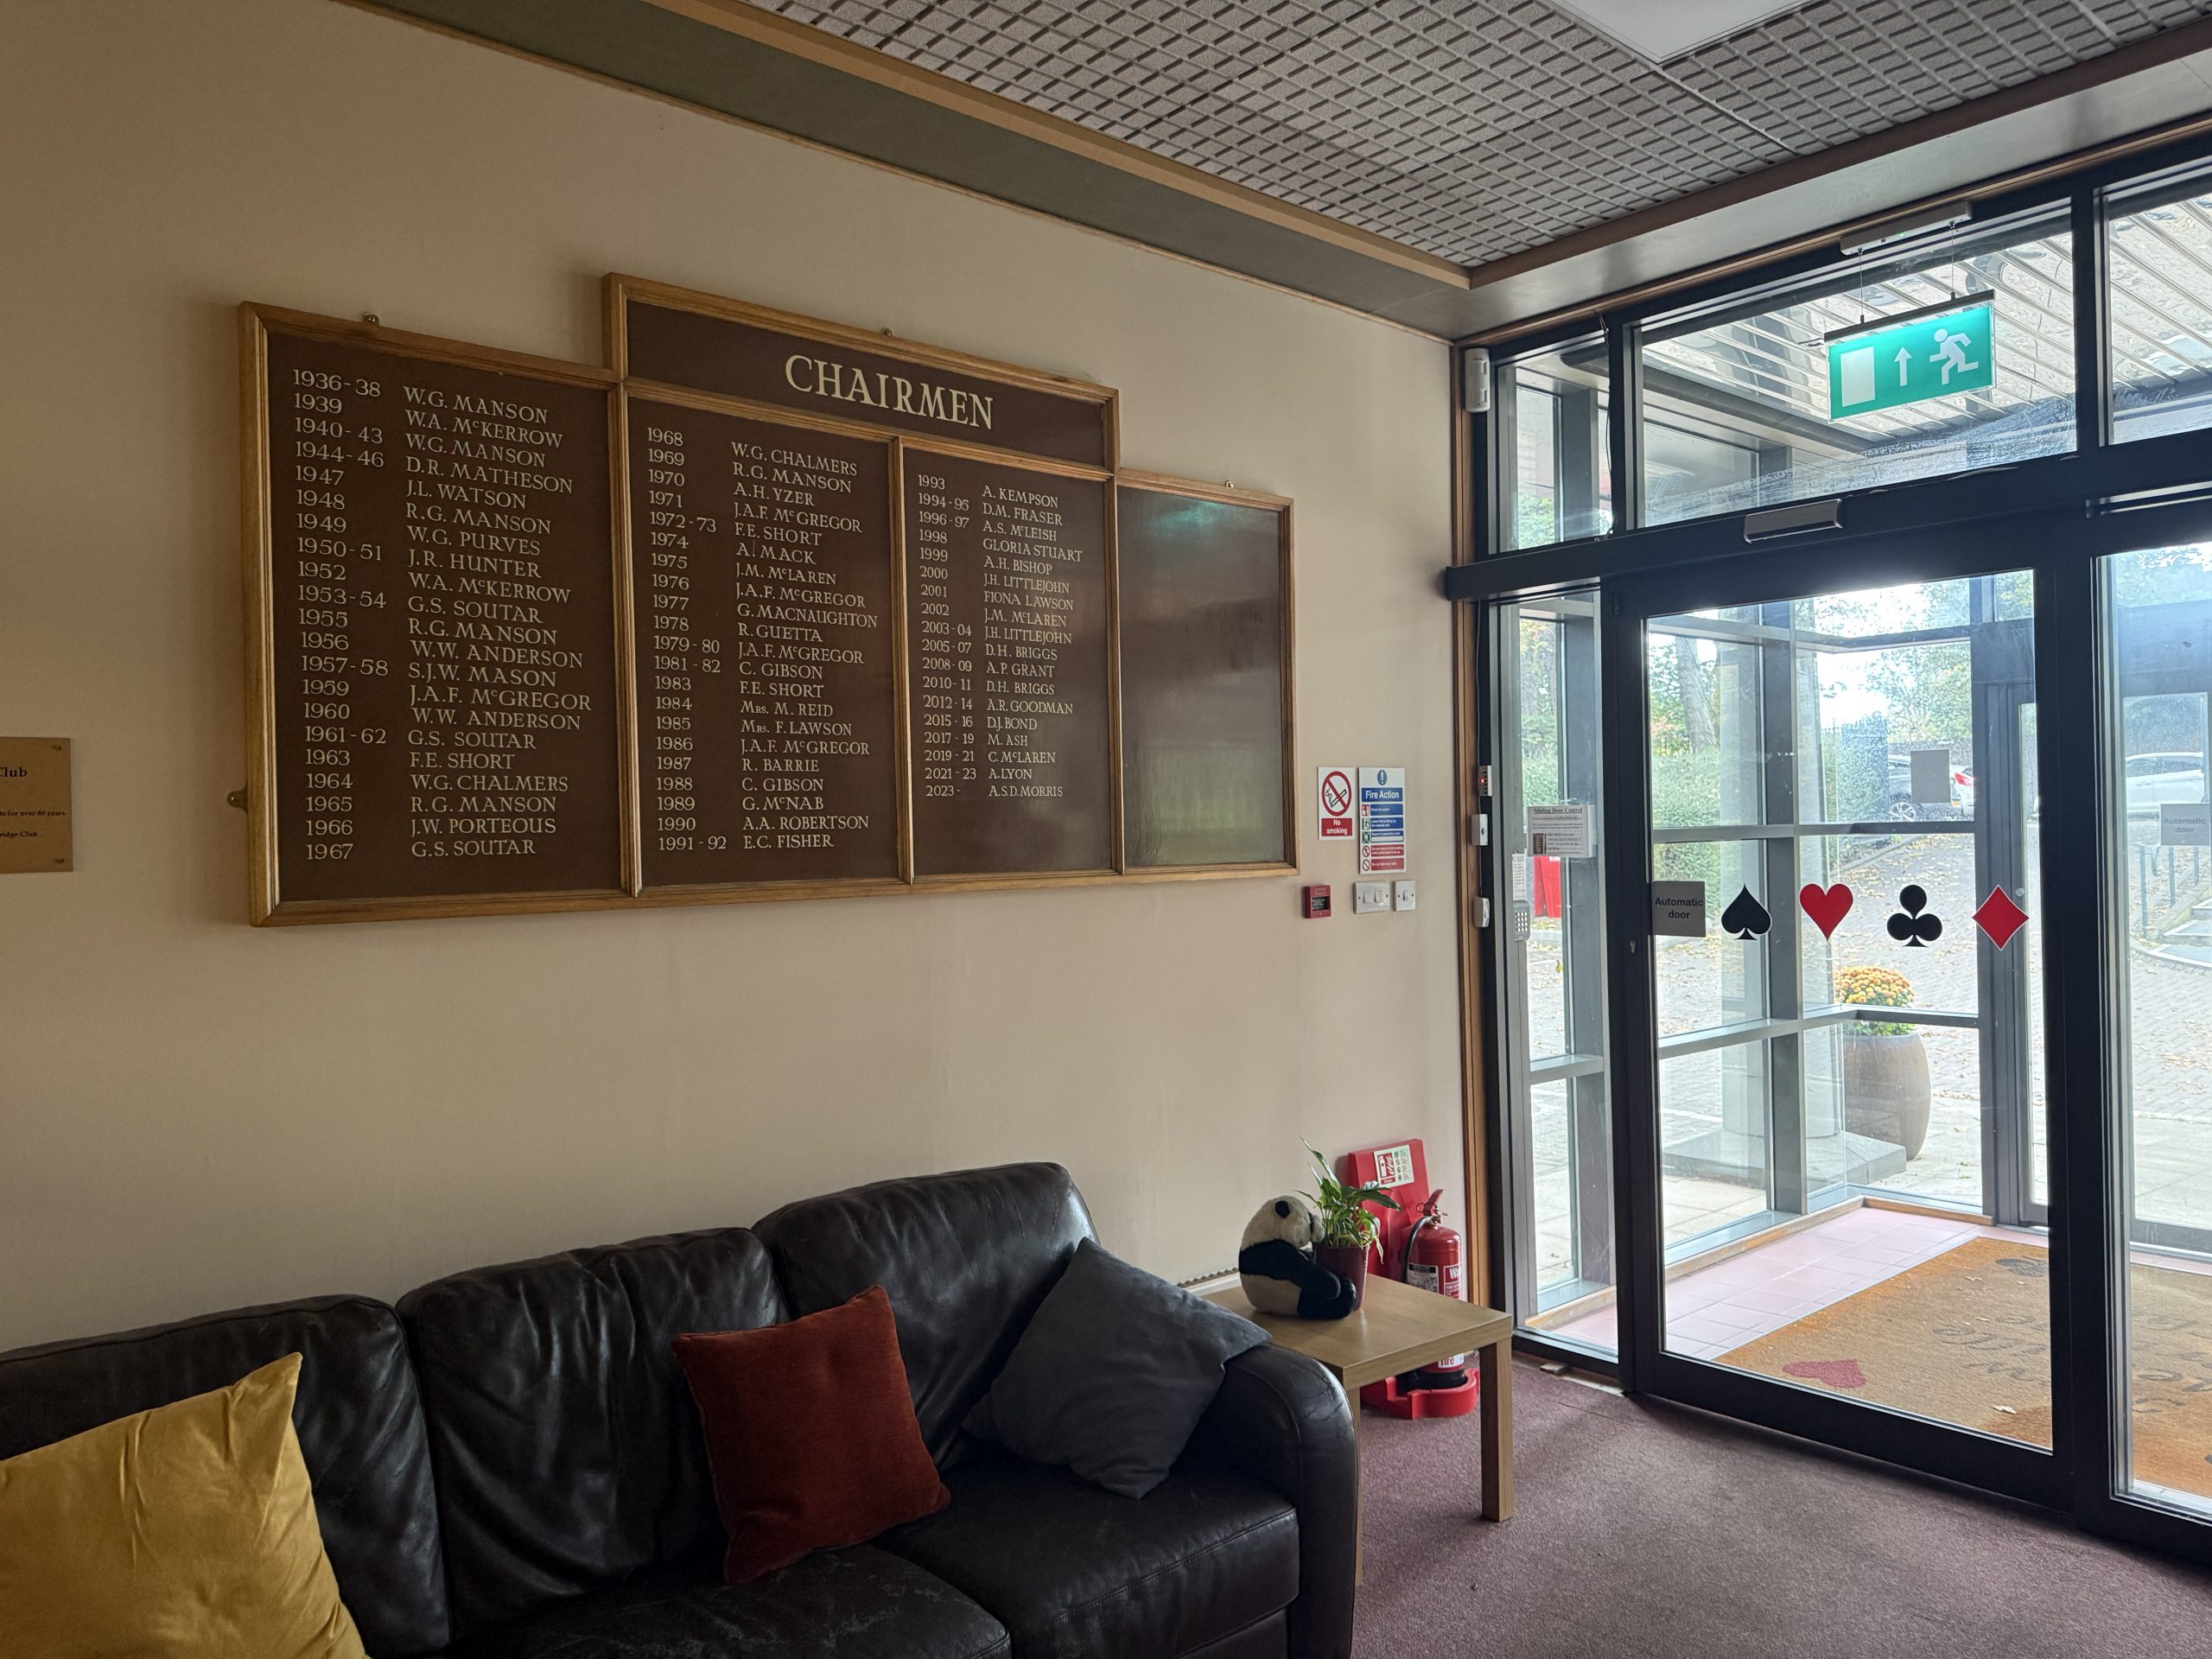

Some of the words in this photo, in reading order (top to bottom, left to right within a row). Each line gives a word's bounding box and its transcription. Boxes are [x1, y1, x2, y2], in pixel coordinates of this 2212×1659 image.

[785, 354, 993, 429] CHAIRMEN
[294, 392, 342, 414] 1939
[452, 394, 548, 424] MANSON
[450, 439, 545, 467] MANSON
[646, 427, 683, 447] 1968
[771, 449, 857, 476] CHALMERS
[449, 462, 573, 493] MATHESON
[648, 448, 684, 466] 1969
[772, 467, 851, 493] MANSON
[296, 464, 344, 486] 1947
[436, 483, 526, 509] WATSON
[648, 468, 684, 486] 1970
[772, 486, 816, 506] YZER
[918, 474, 945, 490] 1993
[998, 487, 1058, 508] KEMPSON
[648, 490, 683, 508] 1971
[296, 488, 345, 510] 1948
[452, 508, 551, 535] MANSON
[1014, 506, 1063, 526] FRASER
[296, 512, 346, 533] 1949
[459, 531, 540, 556] PURVES
[763, 525, 823, 546] SHORT
[650, 531, 689, 549] 1974
[760, 544, 817, 565] MACK
[918, 528, 947, 543] 1998
[982, 537, 1031, 556] GLORIA
[1033, 544, 1083, 562] STUART
[449, 553, 542, 578] HUNTER
[652, 552, 688, 569] 1975
[919, 547, 948, 563] 1999
[1013, 558, 1052, 575] BISHOP
[297, 561, 346, 581] 1952
[919, 565, 948, 580] 2000
[1003, 575, 1070, 594] LITTLEJOHN
[652, 573, 690, 590] 1976
[920, 583, 947, 598] 2001
[983, 590, 1021, 606] FIONA
[1025, 594, 1073, 611] LAWSON
[454, 600, 543, 624] SOUTAR
[652, 594, 690, 611] 1977
[755, 604, 878, 628] MACNAUGHTON
[920, 602, 950, 616] 2002
[298, 607, 348, 628] 1955
[454, 621, 557, 645] MANSON
[653, 614, 689, 632] 1978
[755, 624, 823, 643] GUETTA
[1003, 627, 1072, 645] LITTLEJOHN
[301, 631, 349, 651] 1956
[466, 644, 582, 668] ANDERSON
[1015, 645, 1058, 661] BRIGGS
[467, 665, 556, 687] MASON
[760, 663, 823, 680] GIBSON
[1011, 663, 1055, 677] GRANT
[302, 678, 349, 696] 1959
[654, 675, 691, 690] 1983
[769, 682, 824, 698] SHORT
[1014, 682, 1055, 696] BRIGGS
[303, 702, 350, 719] 1960
[467, 709, 581, 730] ANDERSON
[655, 696, 692, 710] 1984
[797, 702, 833, 716] REID
[1009, 700, 1073, 715] GOODMAN
[656, 715, 691, 730] 1985
[789, 721, 852, 736] LAWSON
[1004, 716, 1038, 730] BOND
[454, 731, 537, 749] SOUTAR
[656, 735, 693, 751] 1986
[1005, 734, 1027, 747] ASH
[305, 748, 350, 766] 1963
[448, 753, 515, 769] SHORT
[656, 756, 692, 771] 1987
[762, 758, 819, 772] BARRIE
[306, 772, 353, 789] 1964
[456, 774, 568, 791] CHALMERS
[656, 777, 693, 791] 1988
[762, 778, 824, 791] GIBSON
[305, 795, 353, 812] 1965
[457, 796, 556, 812] MANSON
[657, 796, 696, 810] 1989
[1365, 790, 1378, 799] Fire
[1379, 790, 1400, 799] Action
[305, 819, 353, 836] 1966
[448, 817, 556, 834] PORTEOUS
[658, 817, 696, 831] 1990
[779, 815, 869, 830] ROBERTSON
[1326, 827, 1348, 836] smoking
[306, 842, 353, 860] 1967
[454, 839, 537, 856] SOUTAR
[776, 834, 835, 849] FISHER
[1655, 897, 1704, 907] Automatic
[1668, 910, 1691, 919] door
